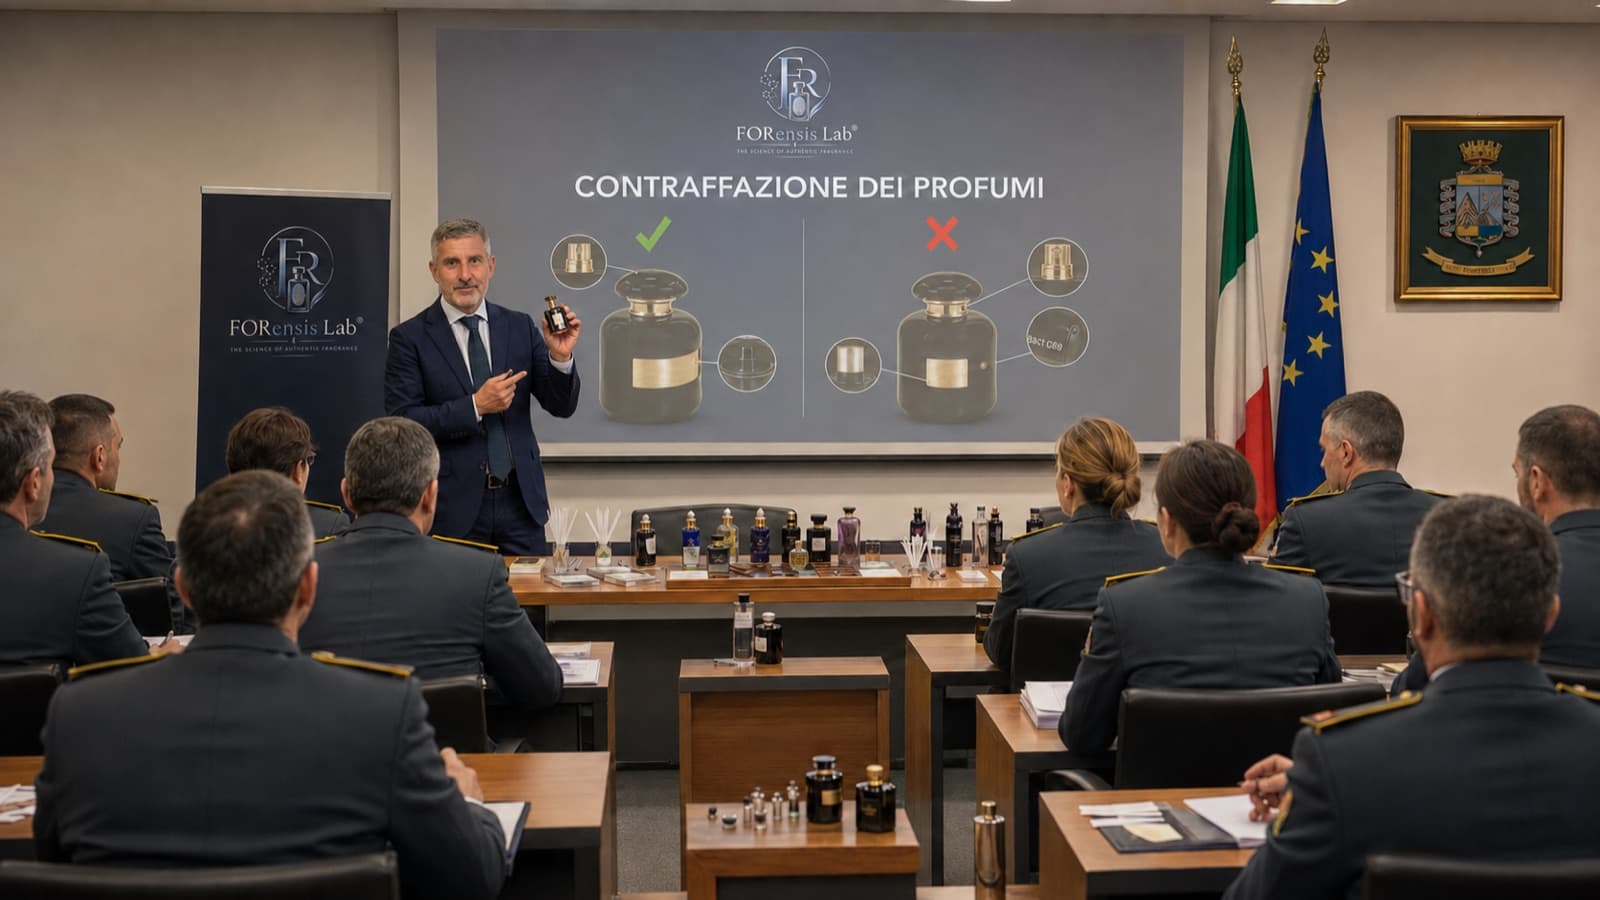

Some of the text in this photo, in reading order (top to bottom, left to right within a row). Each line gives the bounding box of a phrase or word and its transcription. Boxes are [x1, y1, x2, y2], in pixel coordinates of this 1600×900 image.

[737, 126, 817, 141] FORensis
[575, 175, 1044, 198] CONTRAFFAZIONE DEI PROFUMI
[230, 319, 318, 336] FORensis
